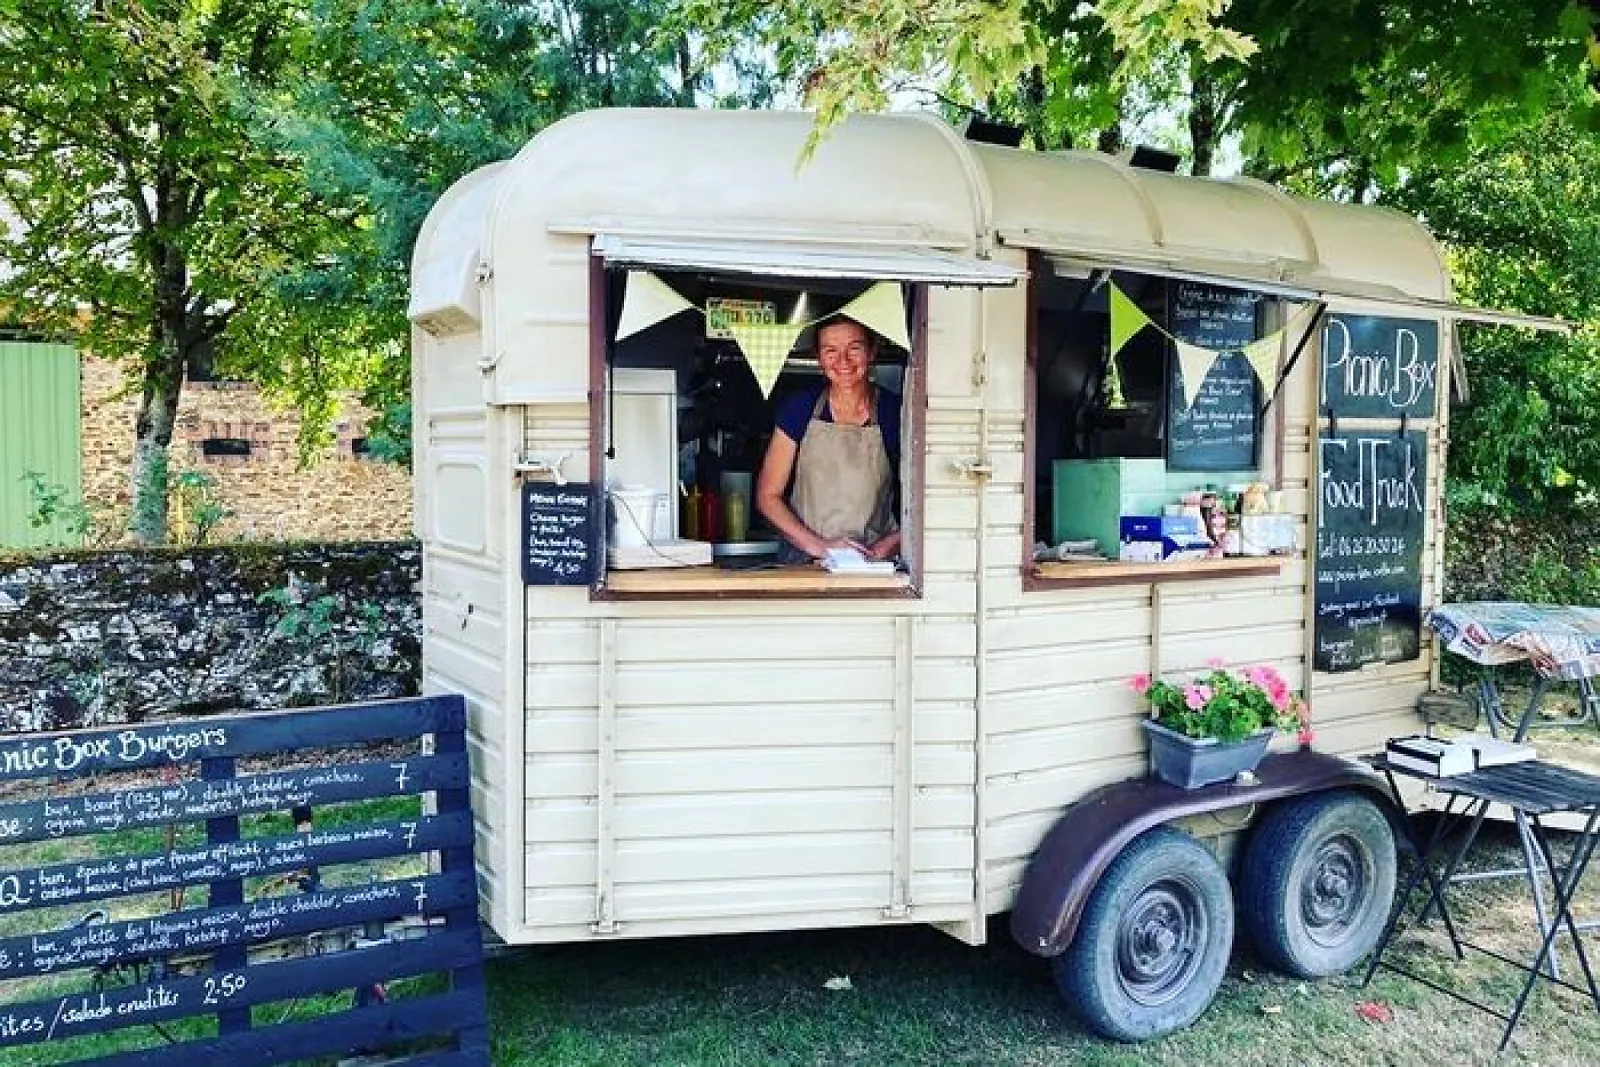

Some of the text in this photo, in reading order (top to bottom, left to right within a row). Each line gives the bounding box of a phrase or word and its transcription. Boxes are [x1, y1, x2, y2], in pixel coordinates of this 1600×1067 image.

[1321, 318, 1437, 407] Picnic Box
[1319, 438, 1423, 528] Food Truck
[0, 727, 227, 772] nic Box Burgers
[390, 763, 410, 789] 7
[400, 822, 417, 848] 7
[411, 882, 427, 910] 7
